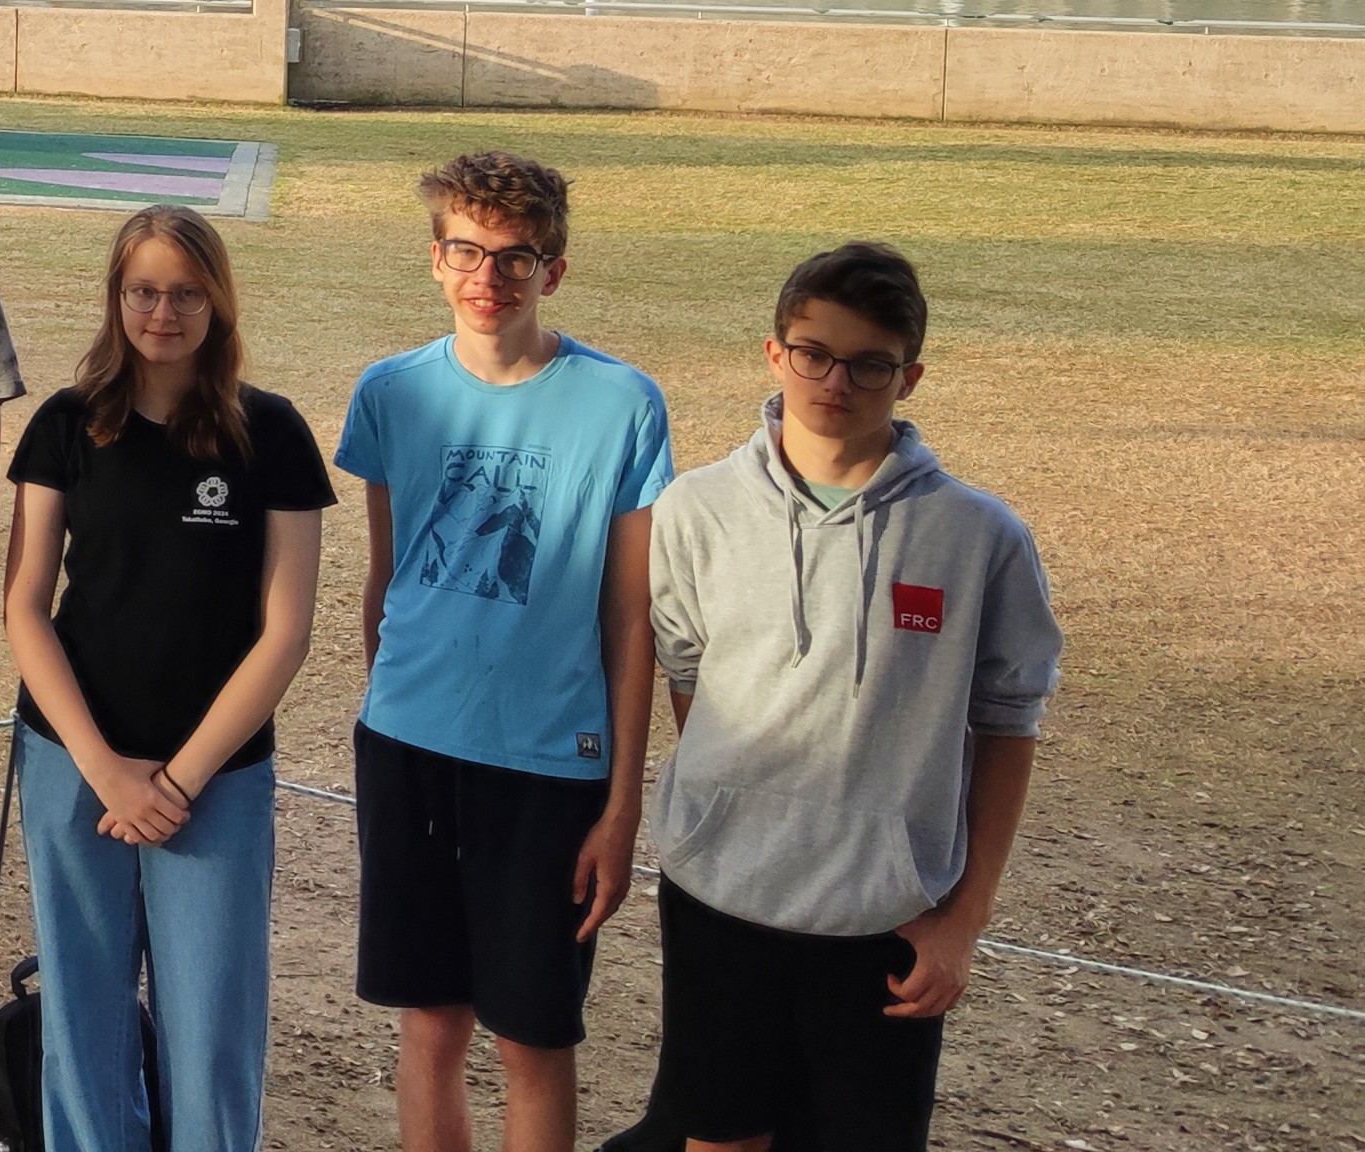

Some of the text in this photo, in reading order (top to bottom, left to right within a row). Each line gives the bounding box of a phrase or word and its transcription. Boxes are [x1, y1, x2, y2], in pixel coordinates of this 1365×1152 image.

[446, 449, 546, 470] MOUNTAIN
[444, 462, 538, 493] CALL
[900, 613, 939, 629] FRC
